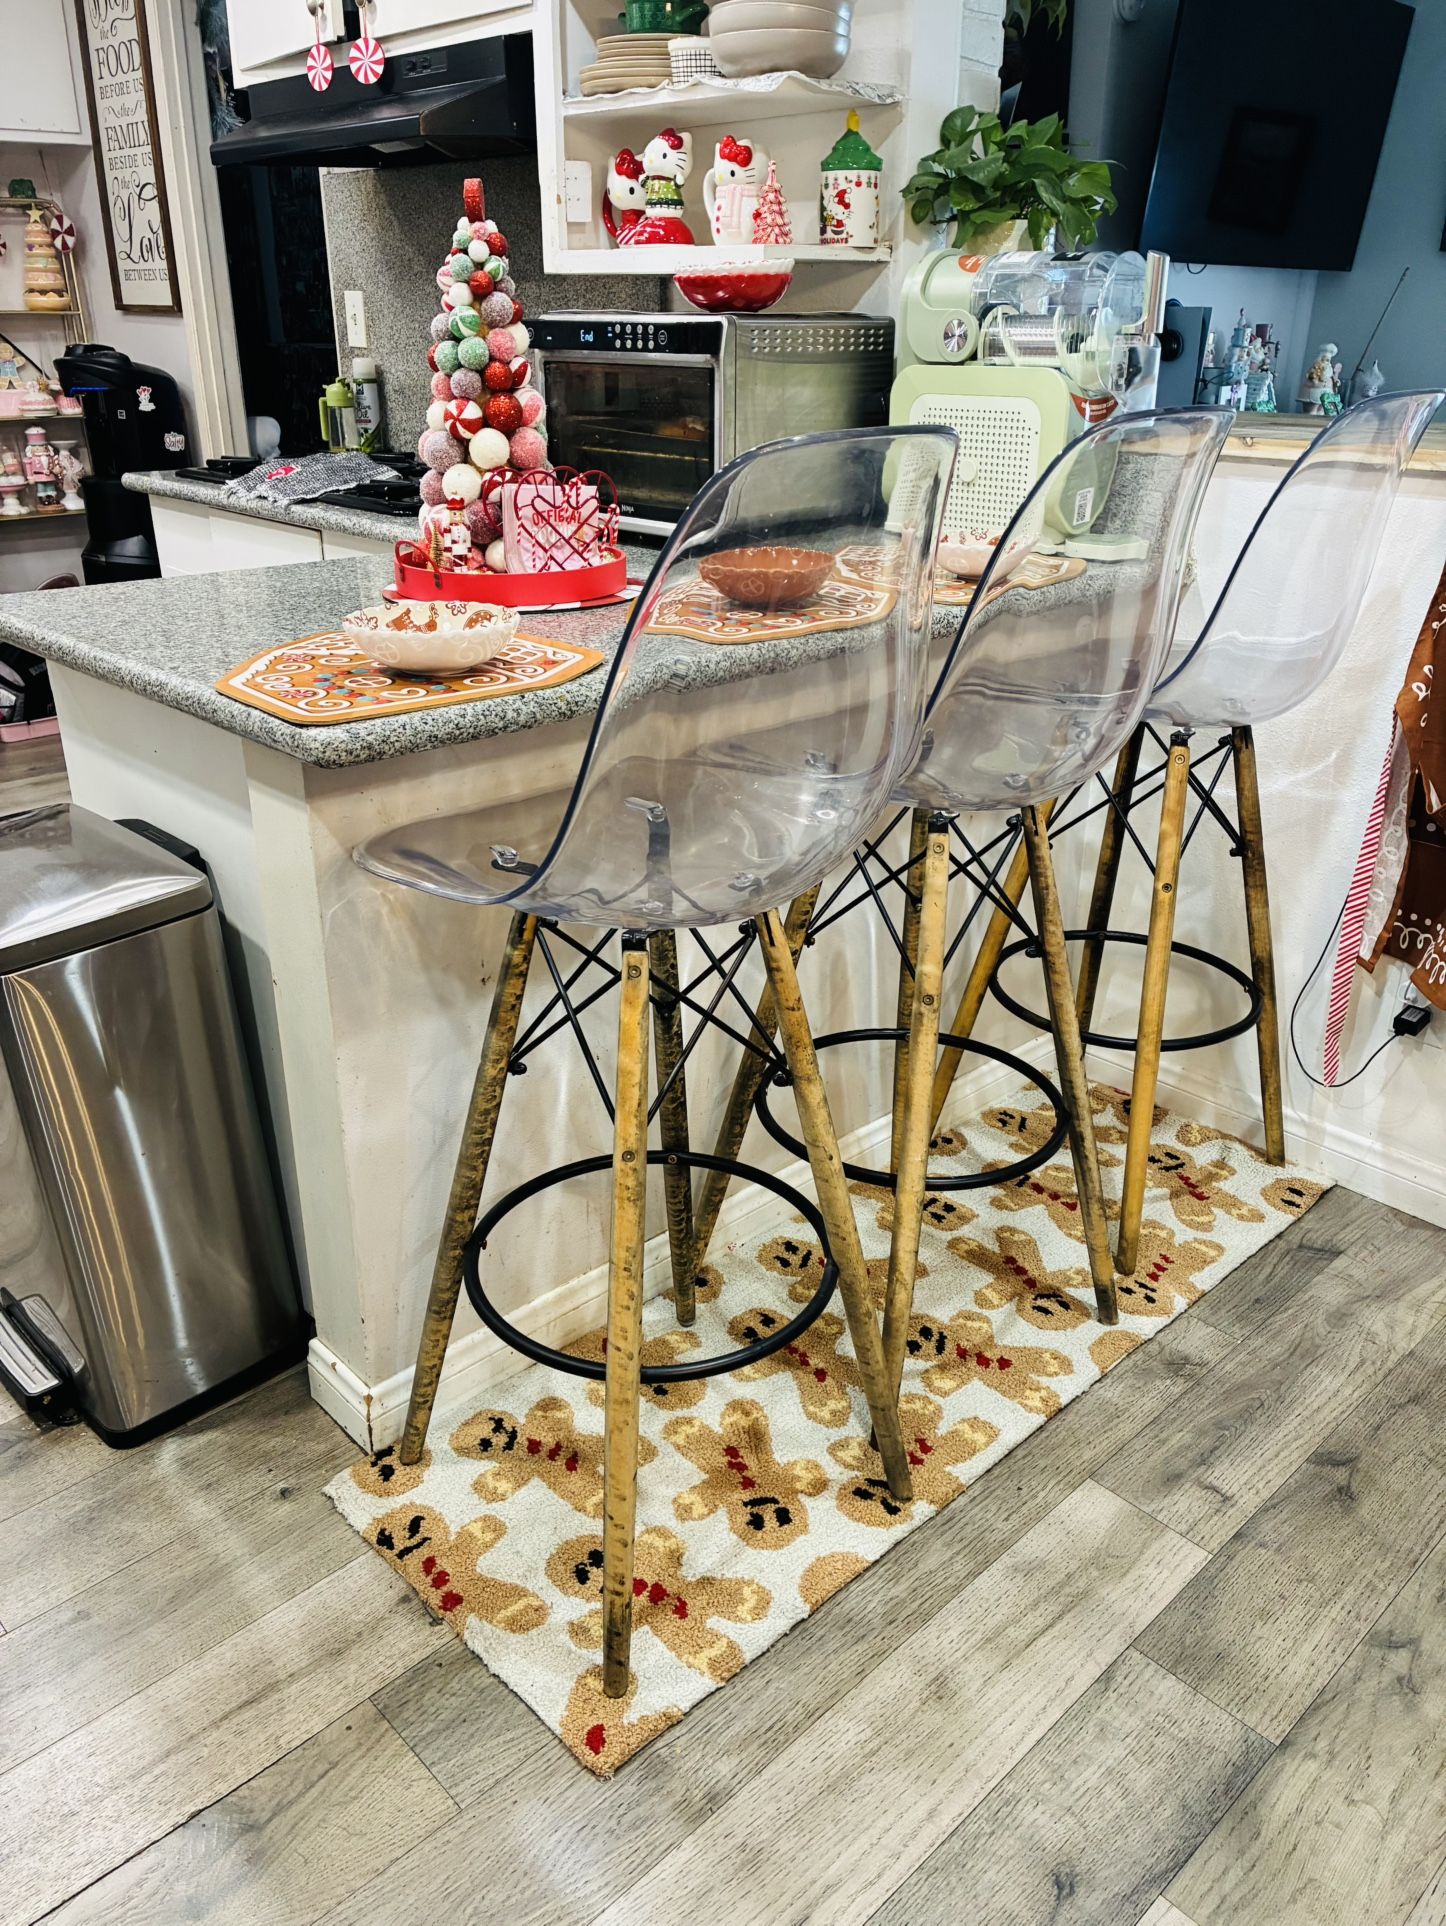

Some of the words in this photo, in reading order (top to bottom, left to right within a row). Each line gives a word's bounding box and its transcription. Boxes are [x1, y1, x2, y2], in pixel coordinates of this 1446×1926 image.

[94, 38, 142, 80] FOOD
[99, 80, 131, 100] BEFORE
[134, 77, 144, 95] US
[104, 120, 151, 152] FAMILY
[108, 153, 139, 171] BESIDE
[142, 151, 153, 167] US
[121, 176, 131, 190] the
[113, 192, 167, 264] Love
[123, 268, 157, 281] BETWEEN
[158, 268, 169, 281] US
[579, 329, 594, 342] End
